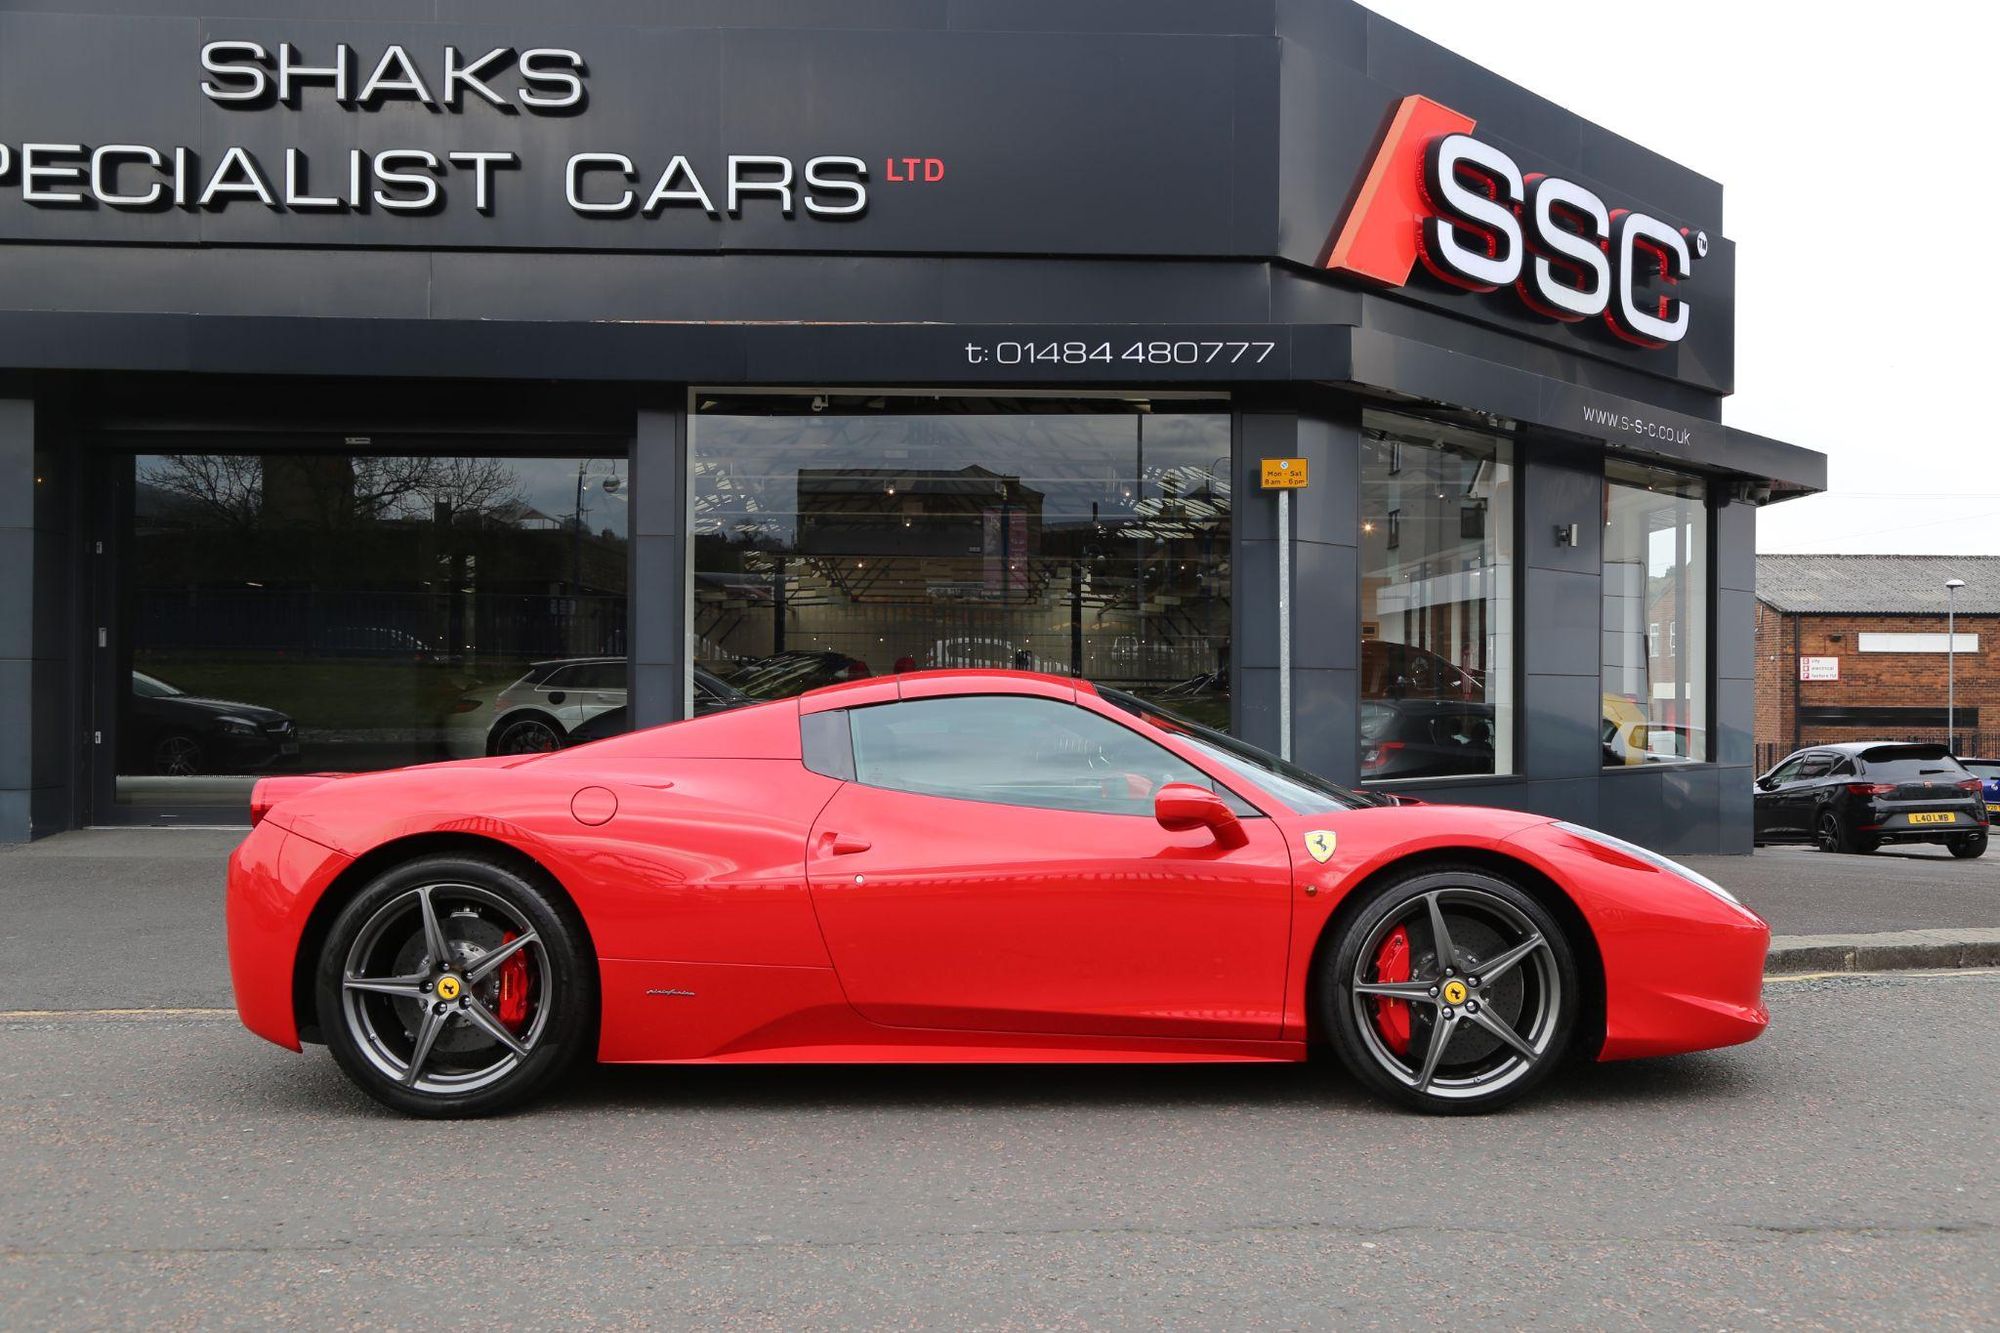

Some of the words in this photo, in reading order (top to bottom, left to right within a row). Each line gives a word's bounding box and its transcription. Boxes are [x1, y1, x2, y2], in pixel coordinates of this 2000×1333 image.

[201, 41, 582, 106] SHAKS
[0, 143, 512, 208] ECIALIST
[565, 152, 866, 214] CARS
[887, 158, 944, 181] LTD
[1436, 133, 1691, 343] SSC
[965, 342, 988, 364] t:
[996, 341, 1113, 364] 01484
[1121, 341, 1275, 364] 480777
